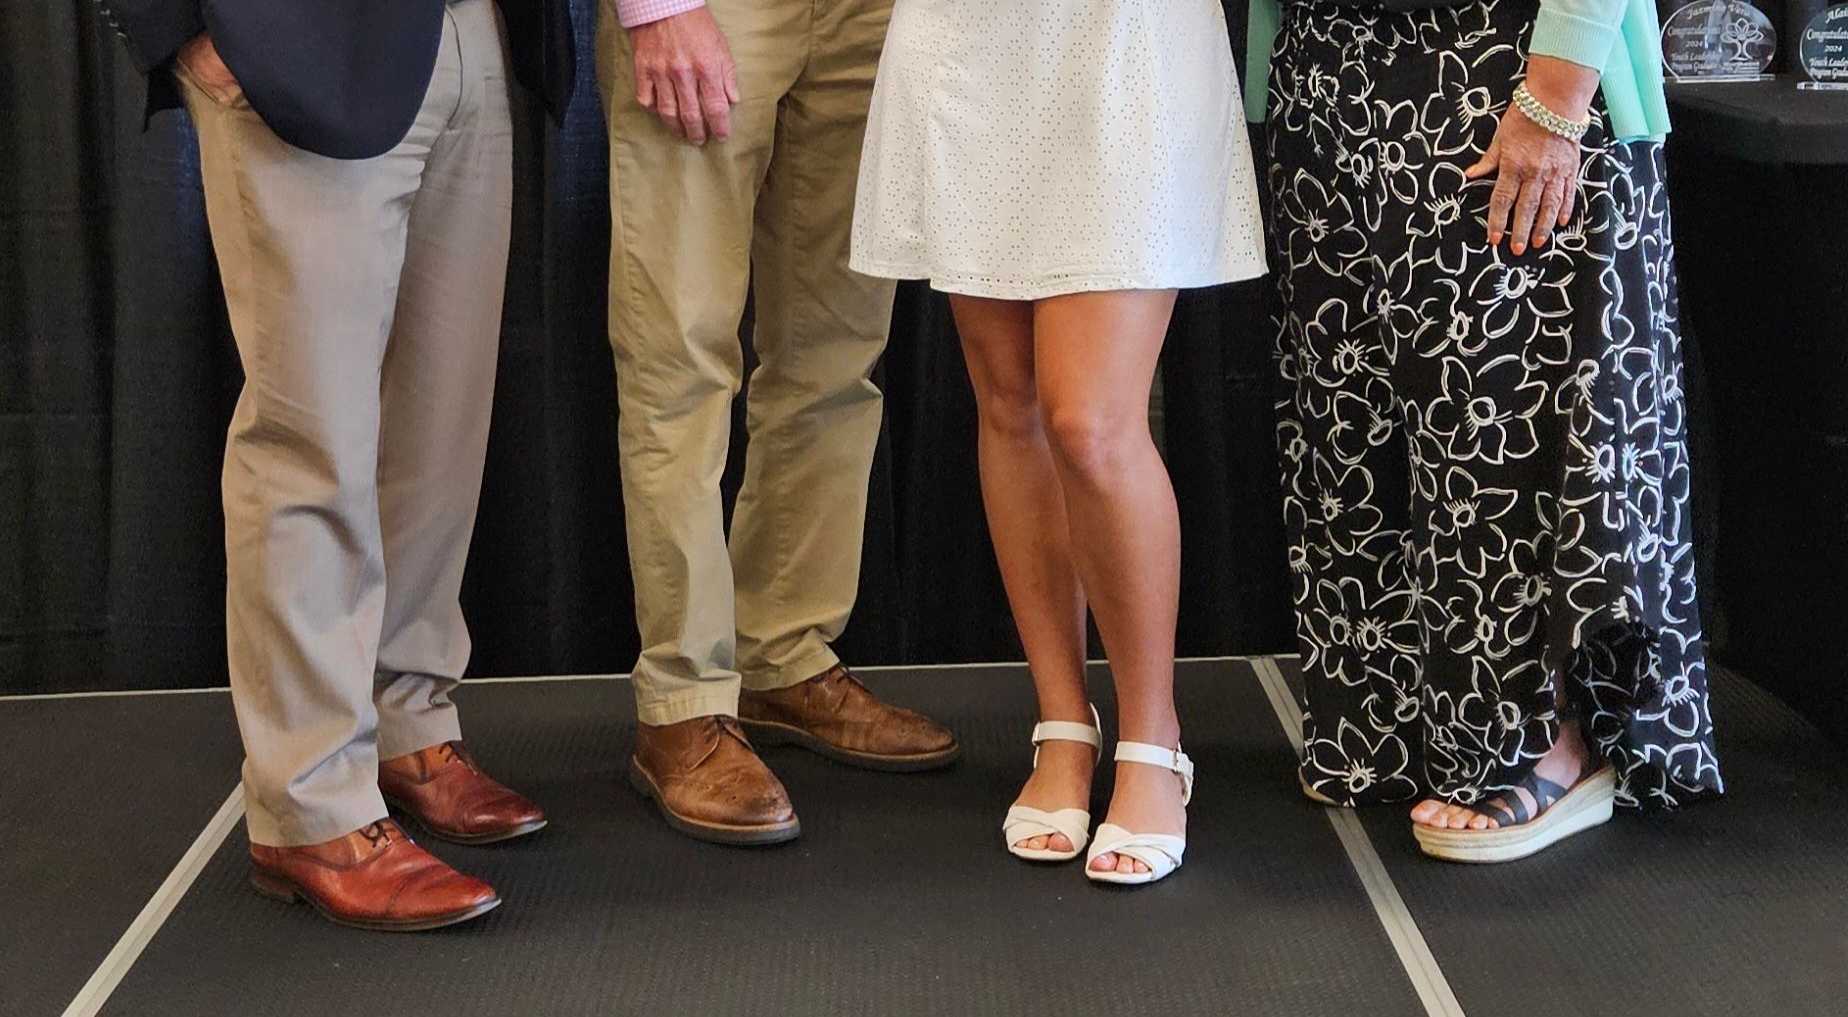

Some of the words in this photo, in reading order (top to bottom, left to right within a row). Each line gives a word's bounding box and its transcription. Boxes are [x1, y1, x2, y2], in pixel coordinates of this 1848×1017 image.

[1685, 40, 1703, 48] 2024
[1824, 45, 1843, 53] 2024
[1809, 56, 1828, 67] Youth
